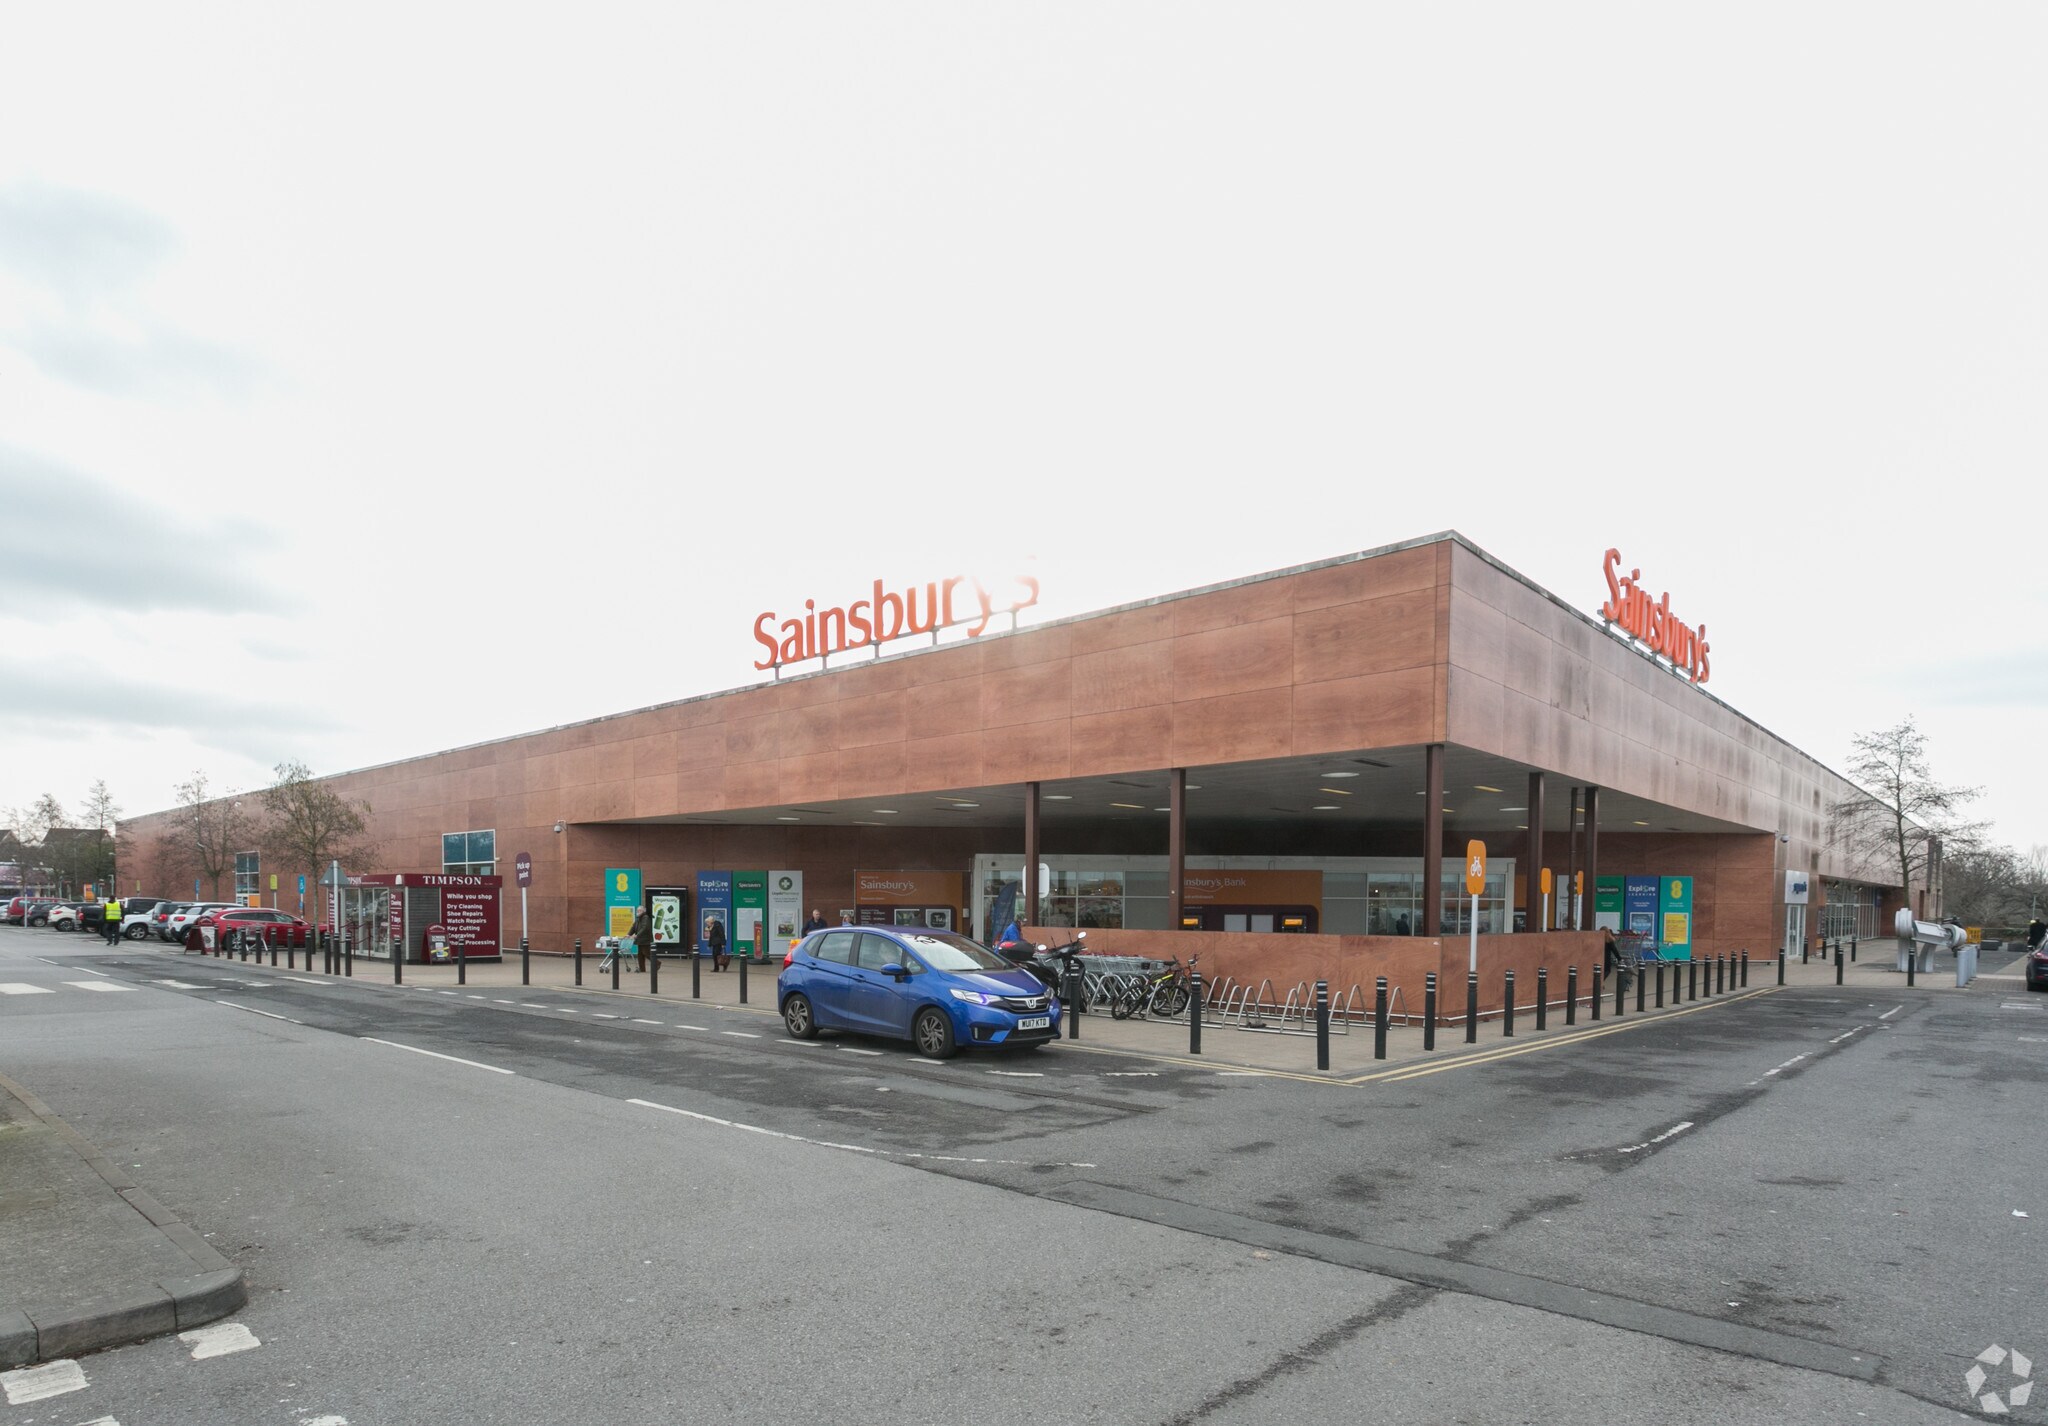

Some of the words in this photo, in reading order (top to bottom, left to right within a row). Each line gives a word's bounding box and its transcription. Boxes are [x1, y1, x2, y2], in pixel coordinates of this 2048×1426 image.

[754, 555, 1039, 671] Sainsburys
[423, 875, 482, 885] TIMPSON
[701, 880, 729, 888] Explore
[1184, 877, 1221, 888] insbury's
[1224, 877, 1246, 887] Bank
[860, 880, 914, 891] Sainsbury's
[1628, 884, 1656, 892] Explore
